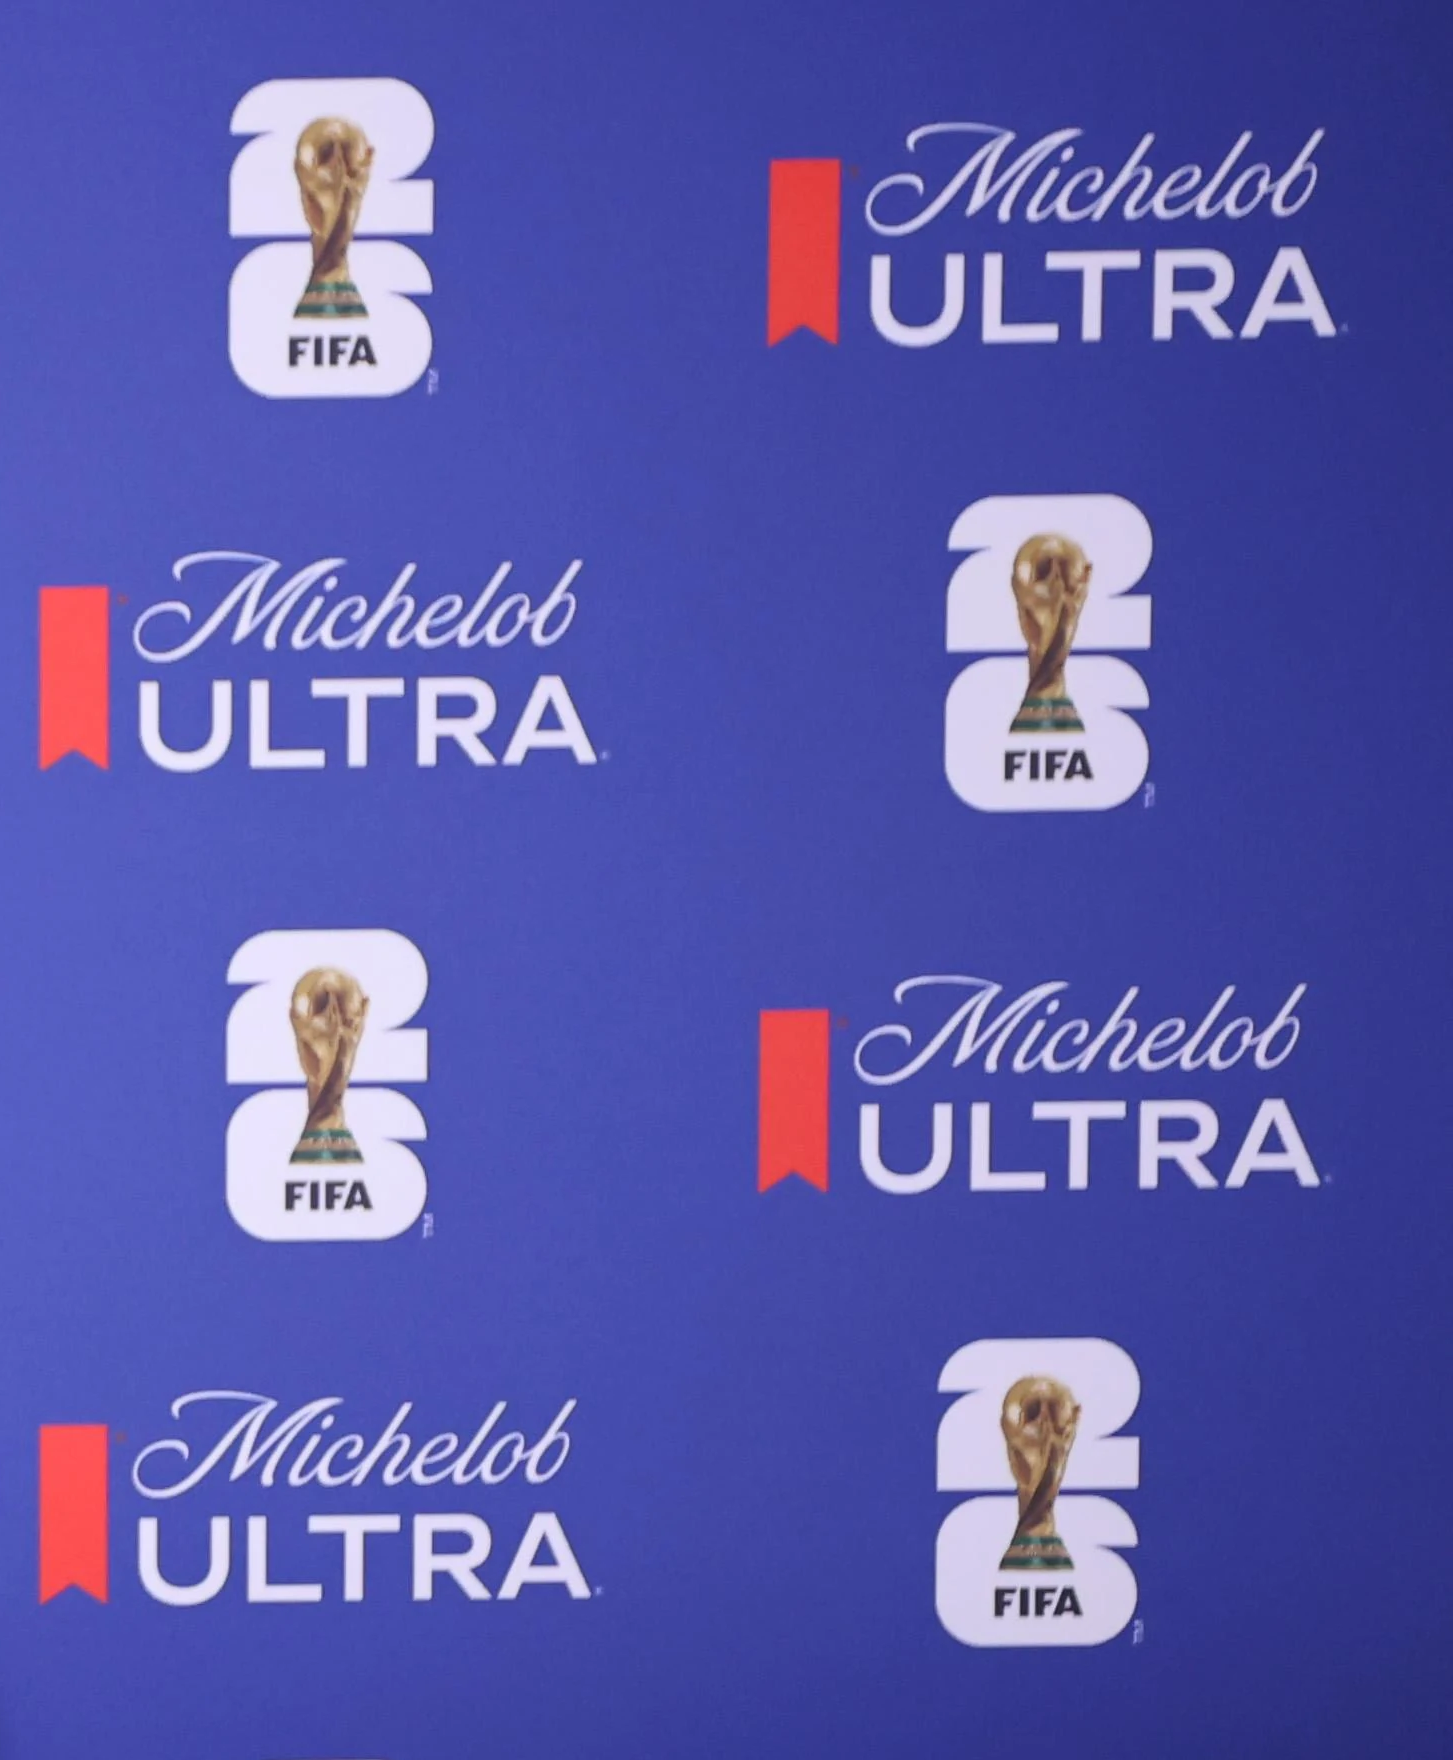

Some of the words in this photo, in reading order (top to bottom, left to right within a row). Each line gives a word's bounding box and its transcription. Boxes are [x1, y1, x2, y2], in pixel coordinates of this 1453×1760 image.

[866, 123, 1323, 235] Michelob
[870, 247, 1336, 347] ULTRA
[288, 336, 377, 367] FIFA
[133, 551, 582, 662] Michelob
[139, 675, 597, 773] ULTRA
[1004, 749, 1093, 781] FIFA
[854, 976, 1306, 1085] Michelob
[860, 1099, 1320, 1194] ULTRA
[284, 1180, 373, 1211] FIFA
[132, 1391, 576, 1498] Michelob
[138, 1512, 591, 1606] ULTRA
[994, 1587, 1083, 1617] FIFA
